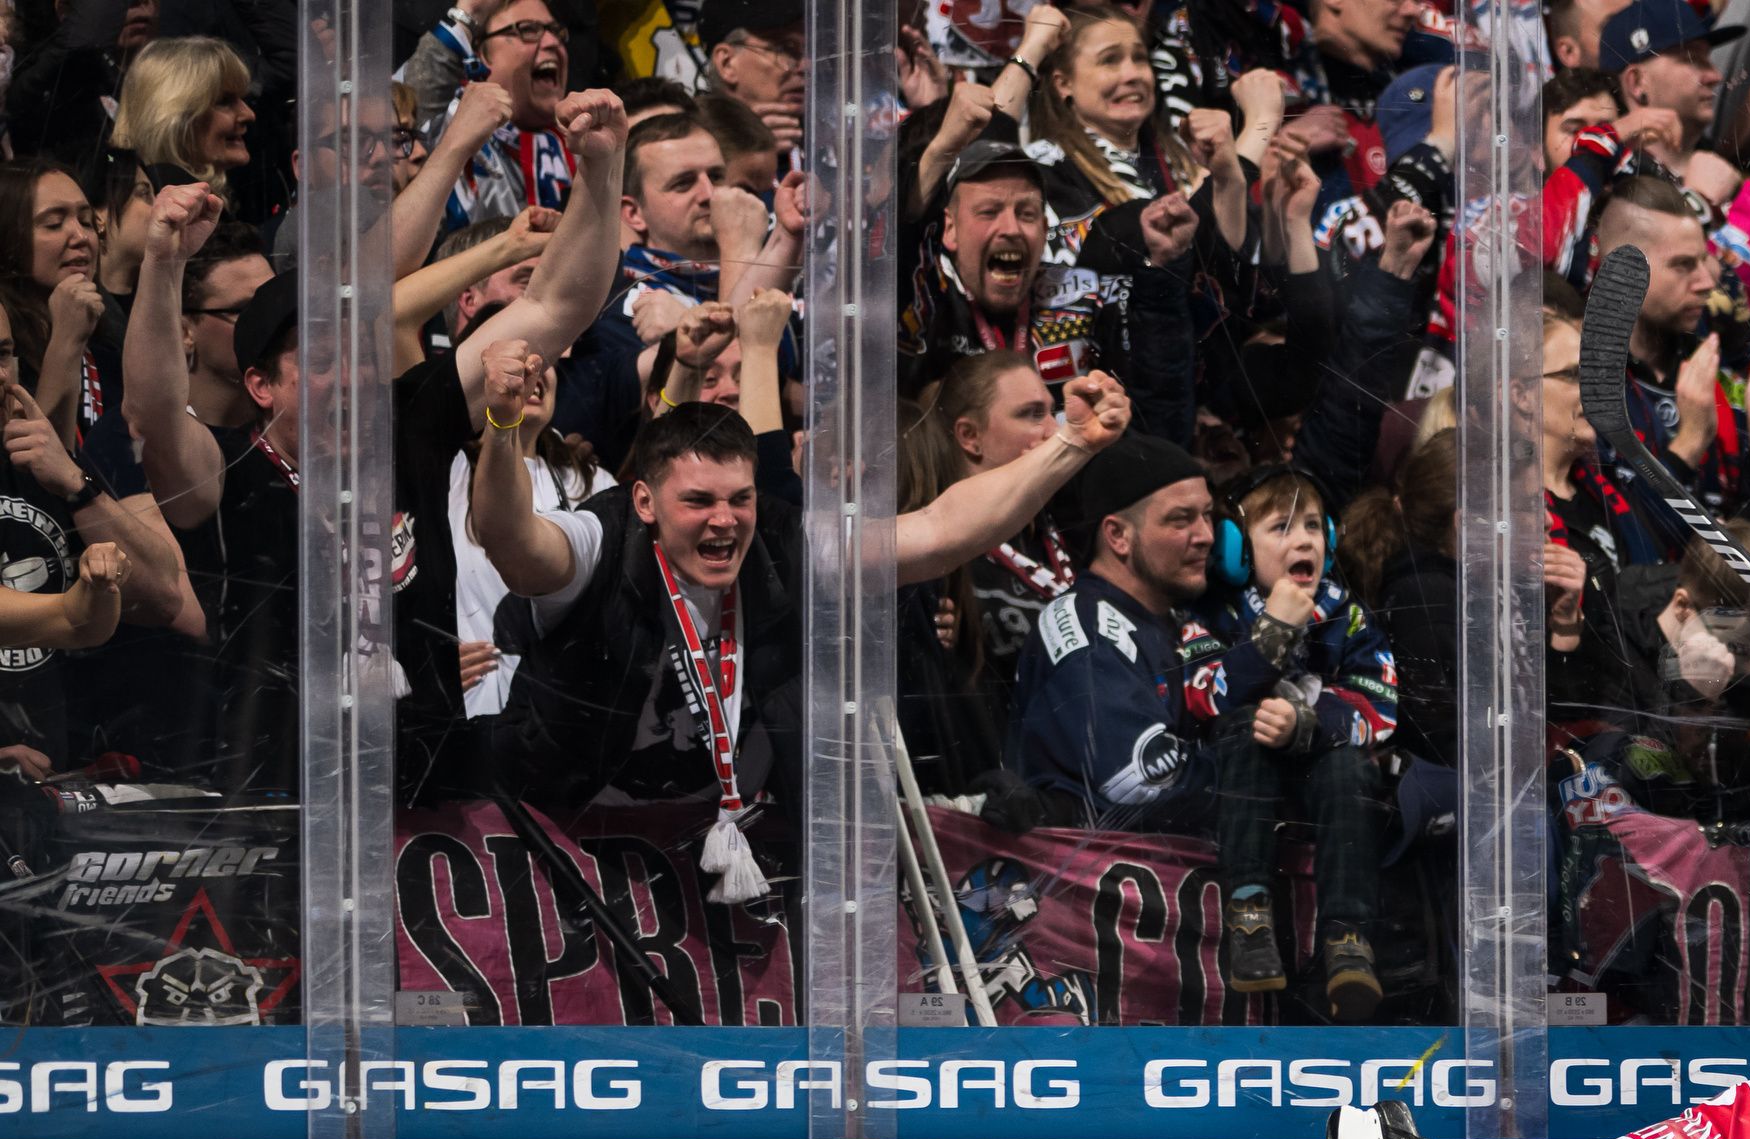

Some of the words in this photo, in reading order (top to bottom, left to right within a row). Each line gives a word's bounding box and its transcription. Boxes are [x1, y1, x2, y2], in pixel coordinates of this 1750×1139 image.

[263, 1058, 642, 1112] GASAG
[700, 1058, 1081, 1111] GASAG
[1143, 1057, 1497, 1109] GASAG
